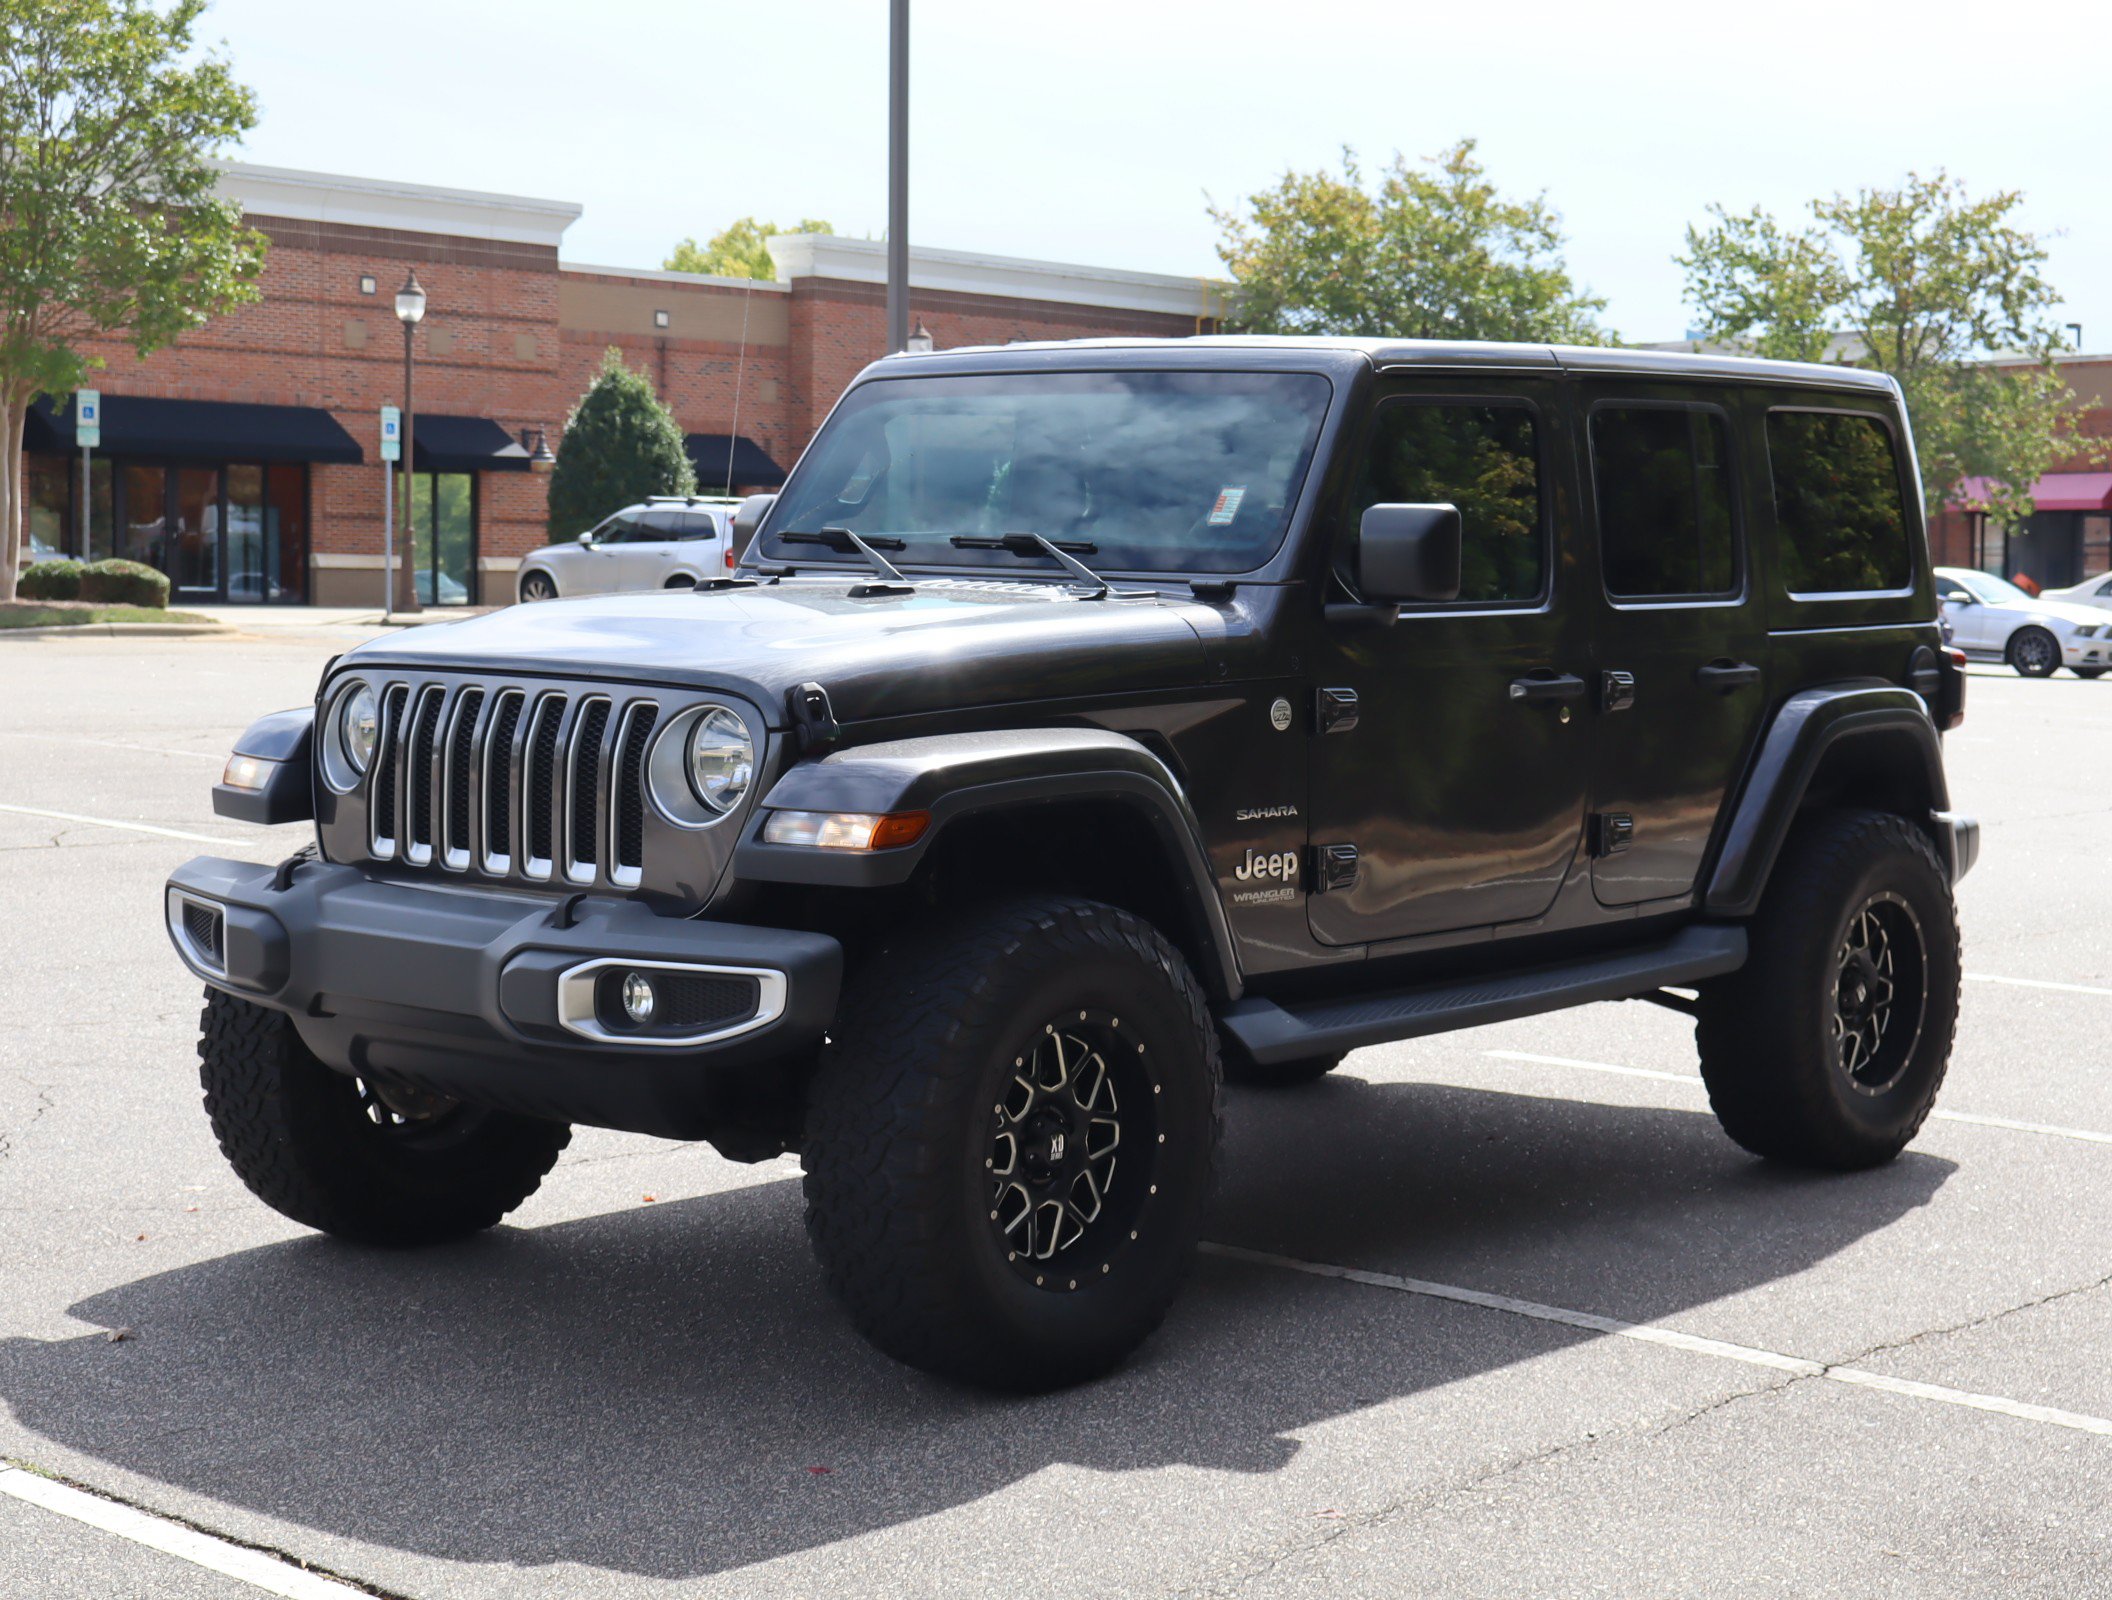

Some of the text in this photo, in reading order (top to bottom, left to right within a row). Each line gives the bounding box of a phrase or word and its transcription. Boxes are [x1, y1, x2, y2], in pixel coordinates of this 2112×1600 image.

[1236, 805, 1298, 821] SAHARA
[1235, 849, 1298, 882] Jeep
[1233, 887, 1295, 903] WRANGLER
